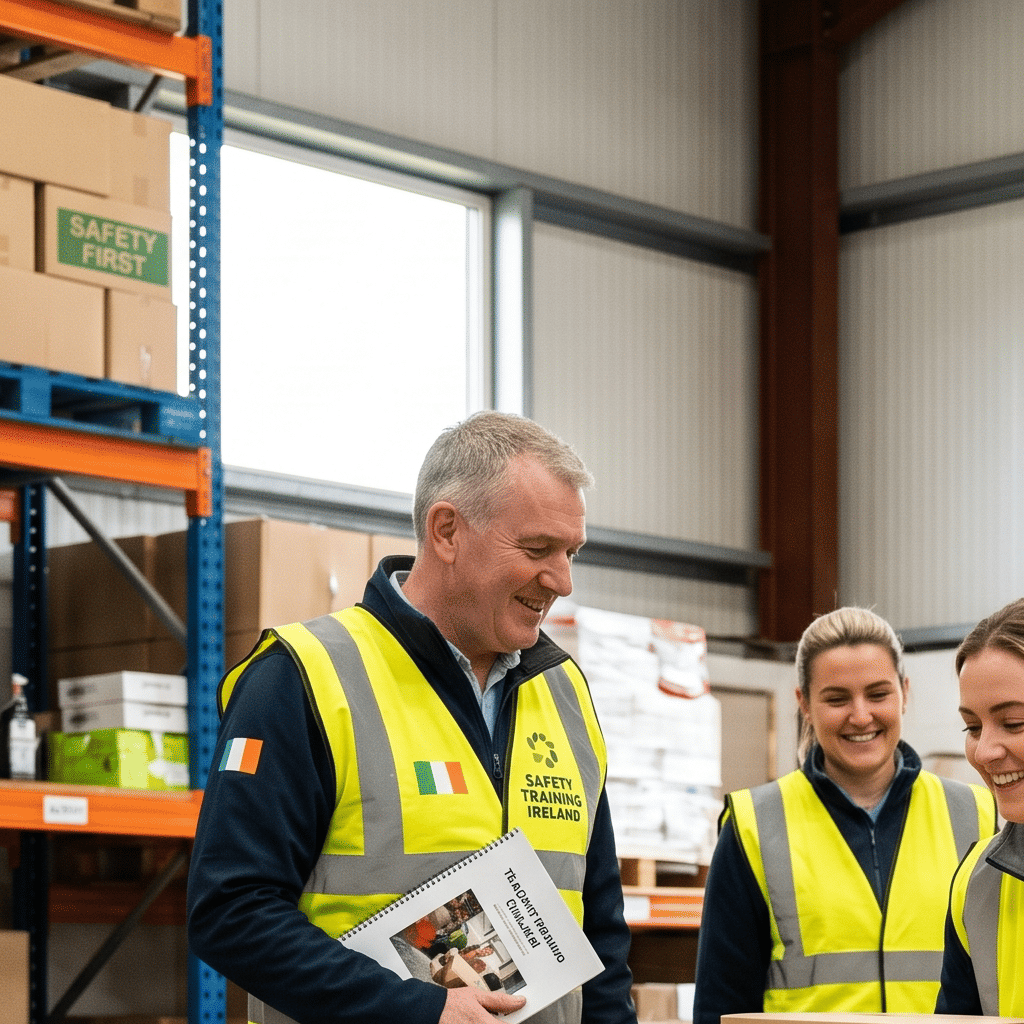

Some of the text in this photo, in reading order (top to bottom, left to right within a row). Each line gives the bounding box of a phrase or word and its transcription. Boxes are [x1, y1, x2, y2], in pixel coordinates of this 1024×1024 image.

[70, 214, 157, 254] SAFETY
[82, 243, 147, 276] FIRST
[525, 773, 572, 791] SAFETY
[521, 788, 582, 808] TRAINING
[527, 805, 581, 822] IRELAND
